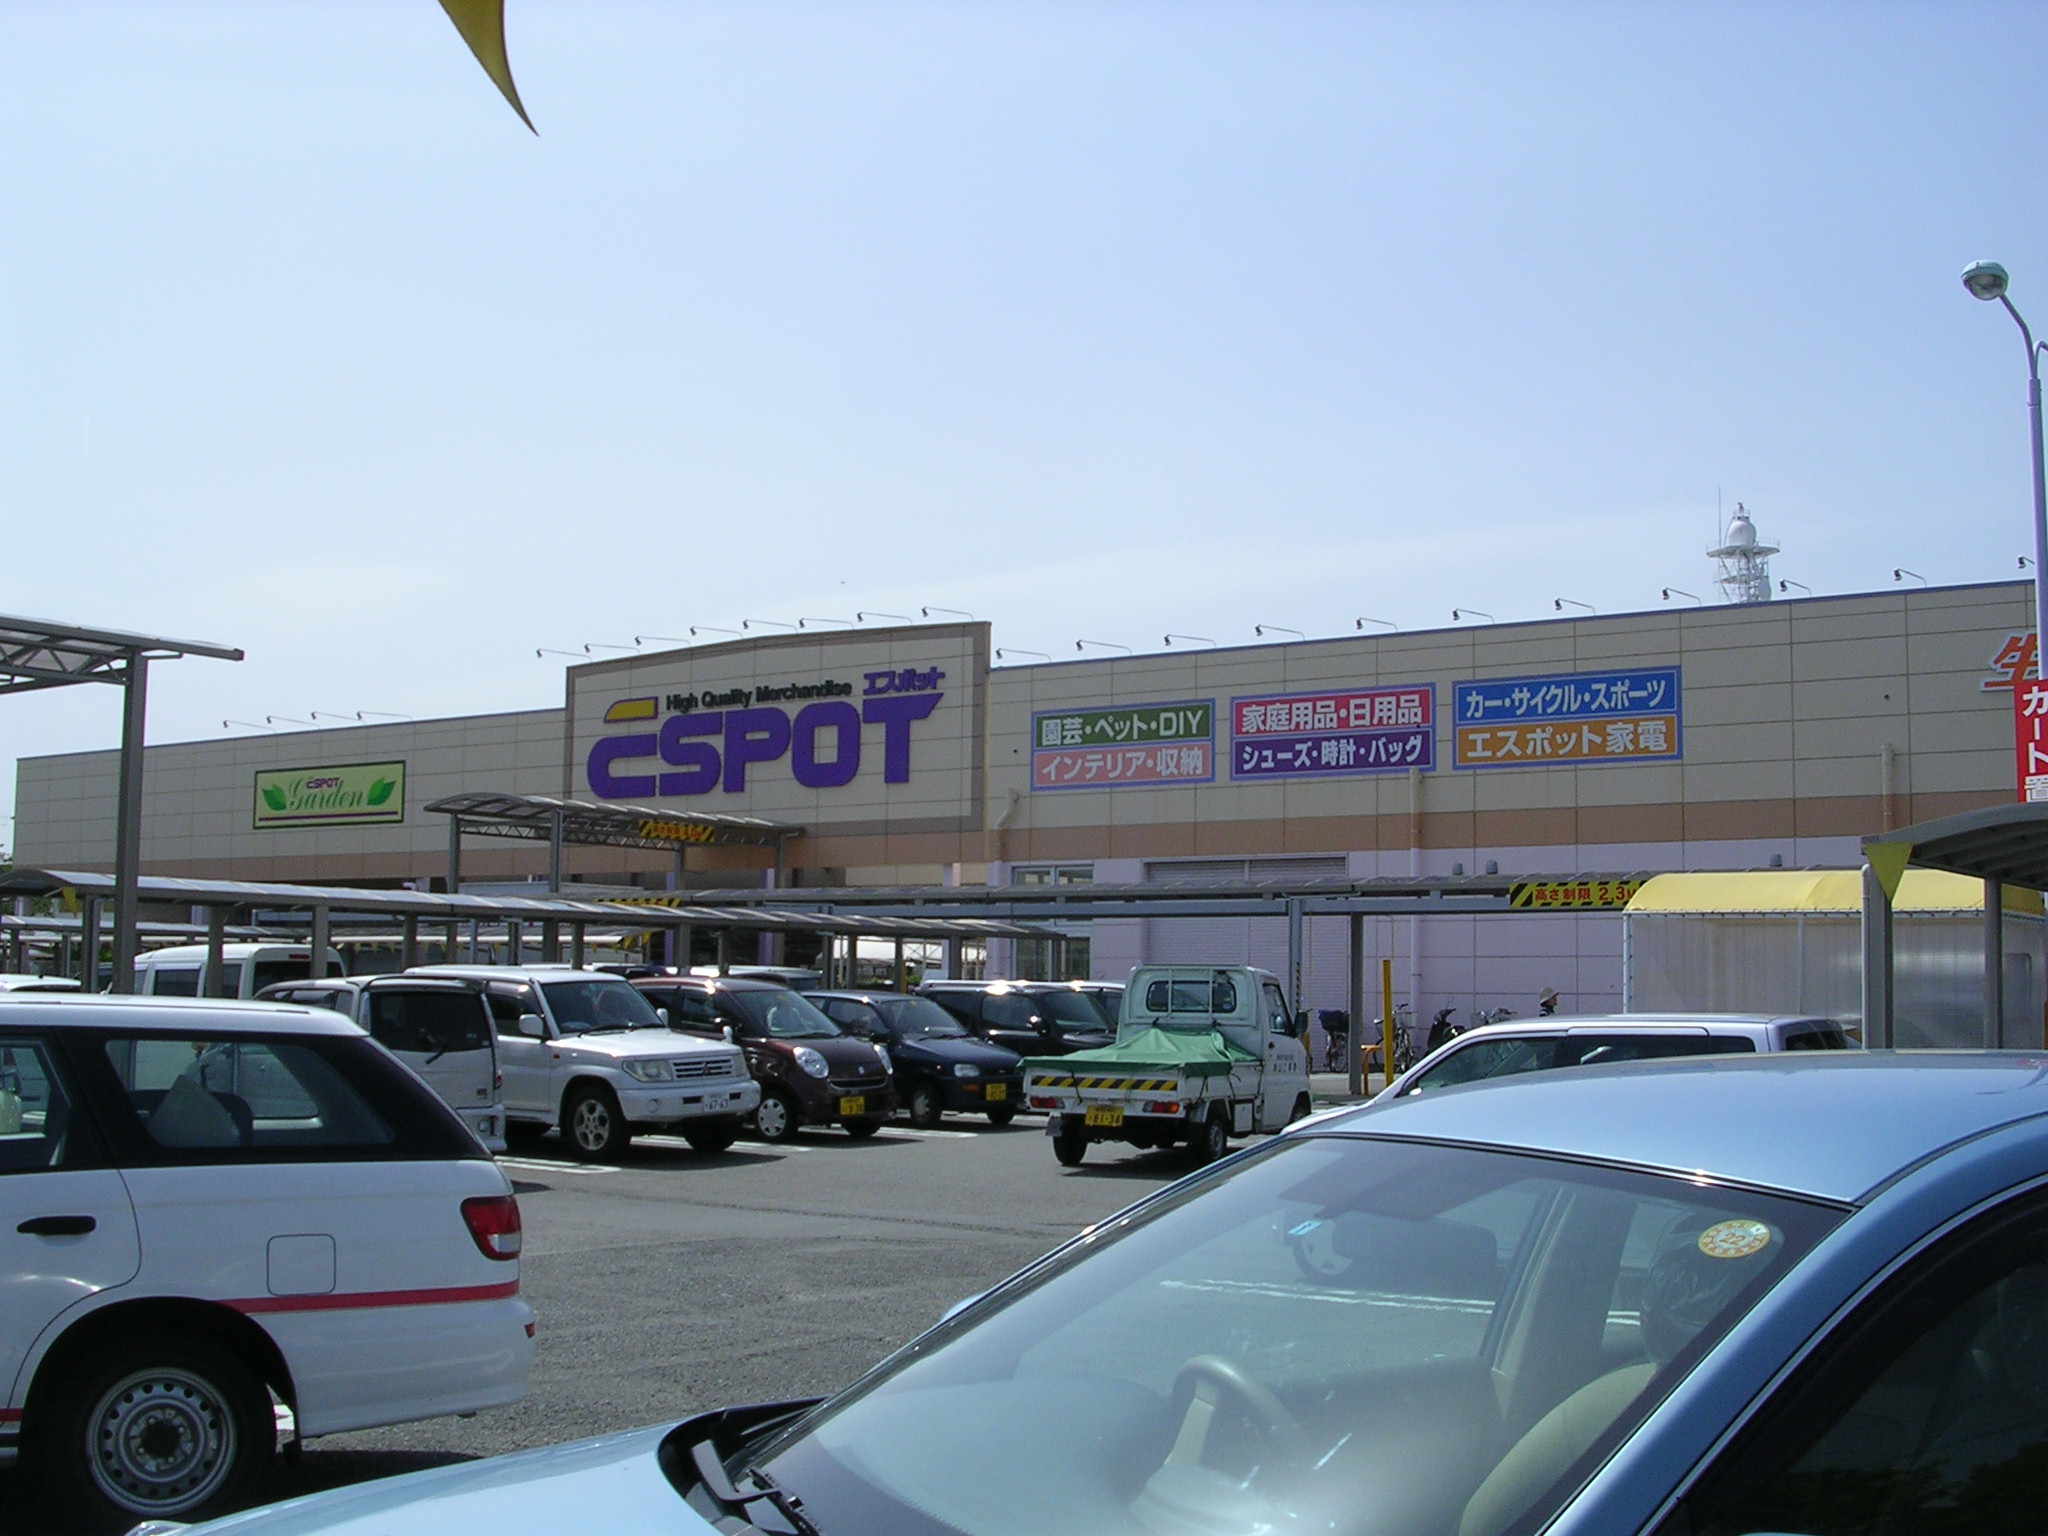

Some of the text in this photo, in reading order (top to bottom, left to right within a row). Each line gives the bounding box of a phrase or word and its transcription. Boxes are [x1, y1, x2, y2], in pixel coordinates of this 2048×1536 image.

[666, 680, 852, 714] High Quality Merchandise
[1242, 694, 1422, 733] 家庭用品・日用品
[1466, 679, 1666, 719] カー・サイクル・スポーツ
[1042, 710, 1203, 746] 園芸・ペット・DIY
[1467, 720, 1668, 758] エスポット家電
[1042, 747, 1203, 781] インテリア・収納
[1243, 734, 1423, 770] シューズ・時計・バッグ
[289, 778, 363, 811] Garden
[1535, 887, 1591, 901] 高さ制限
